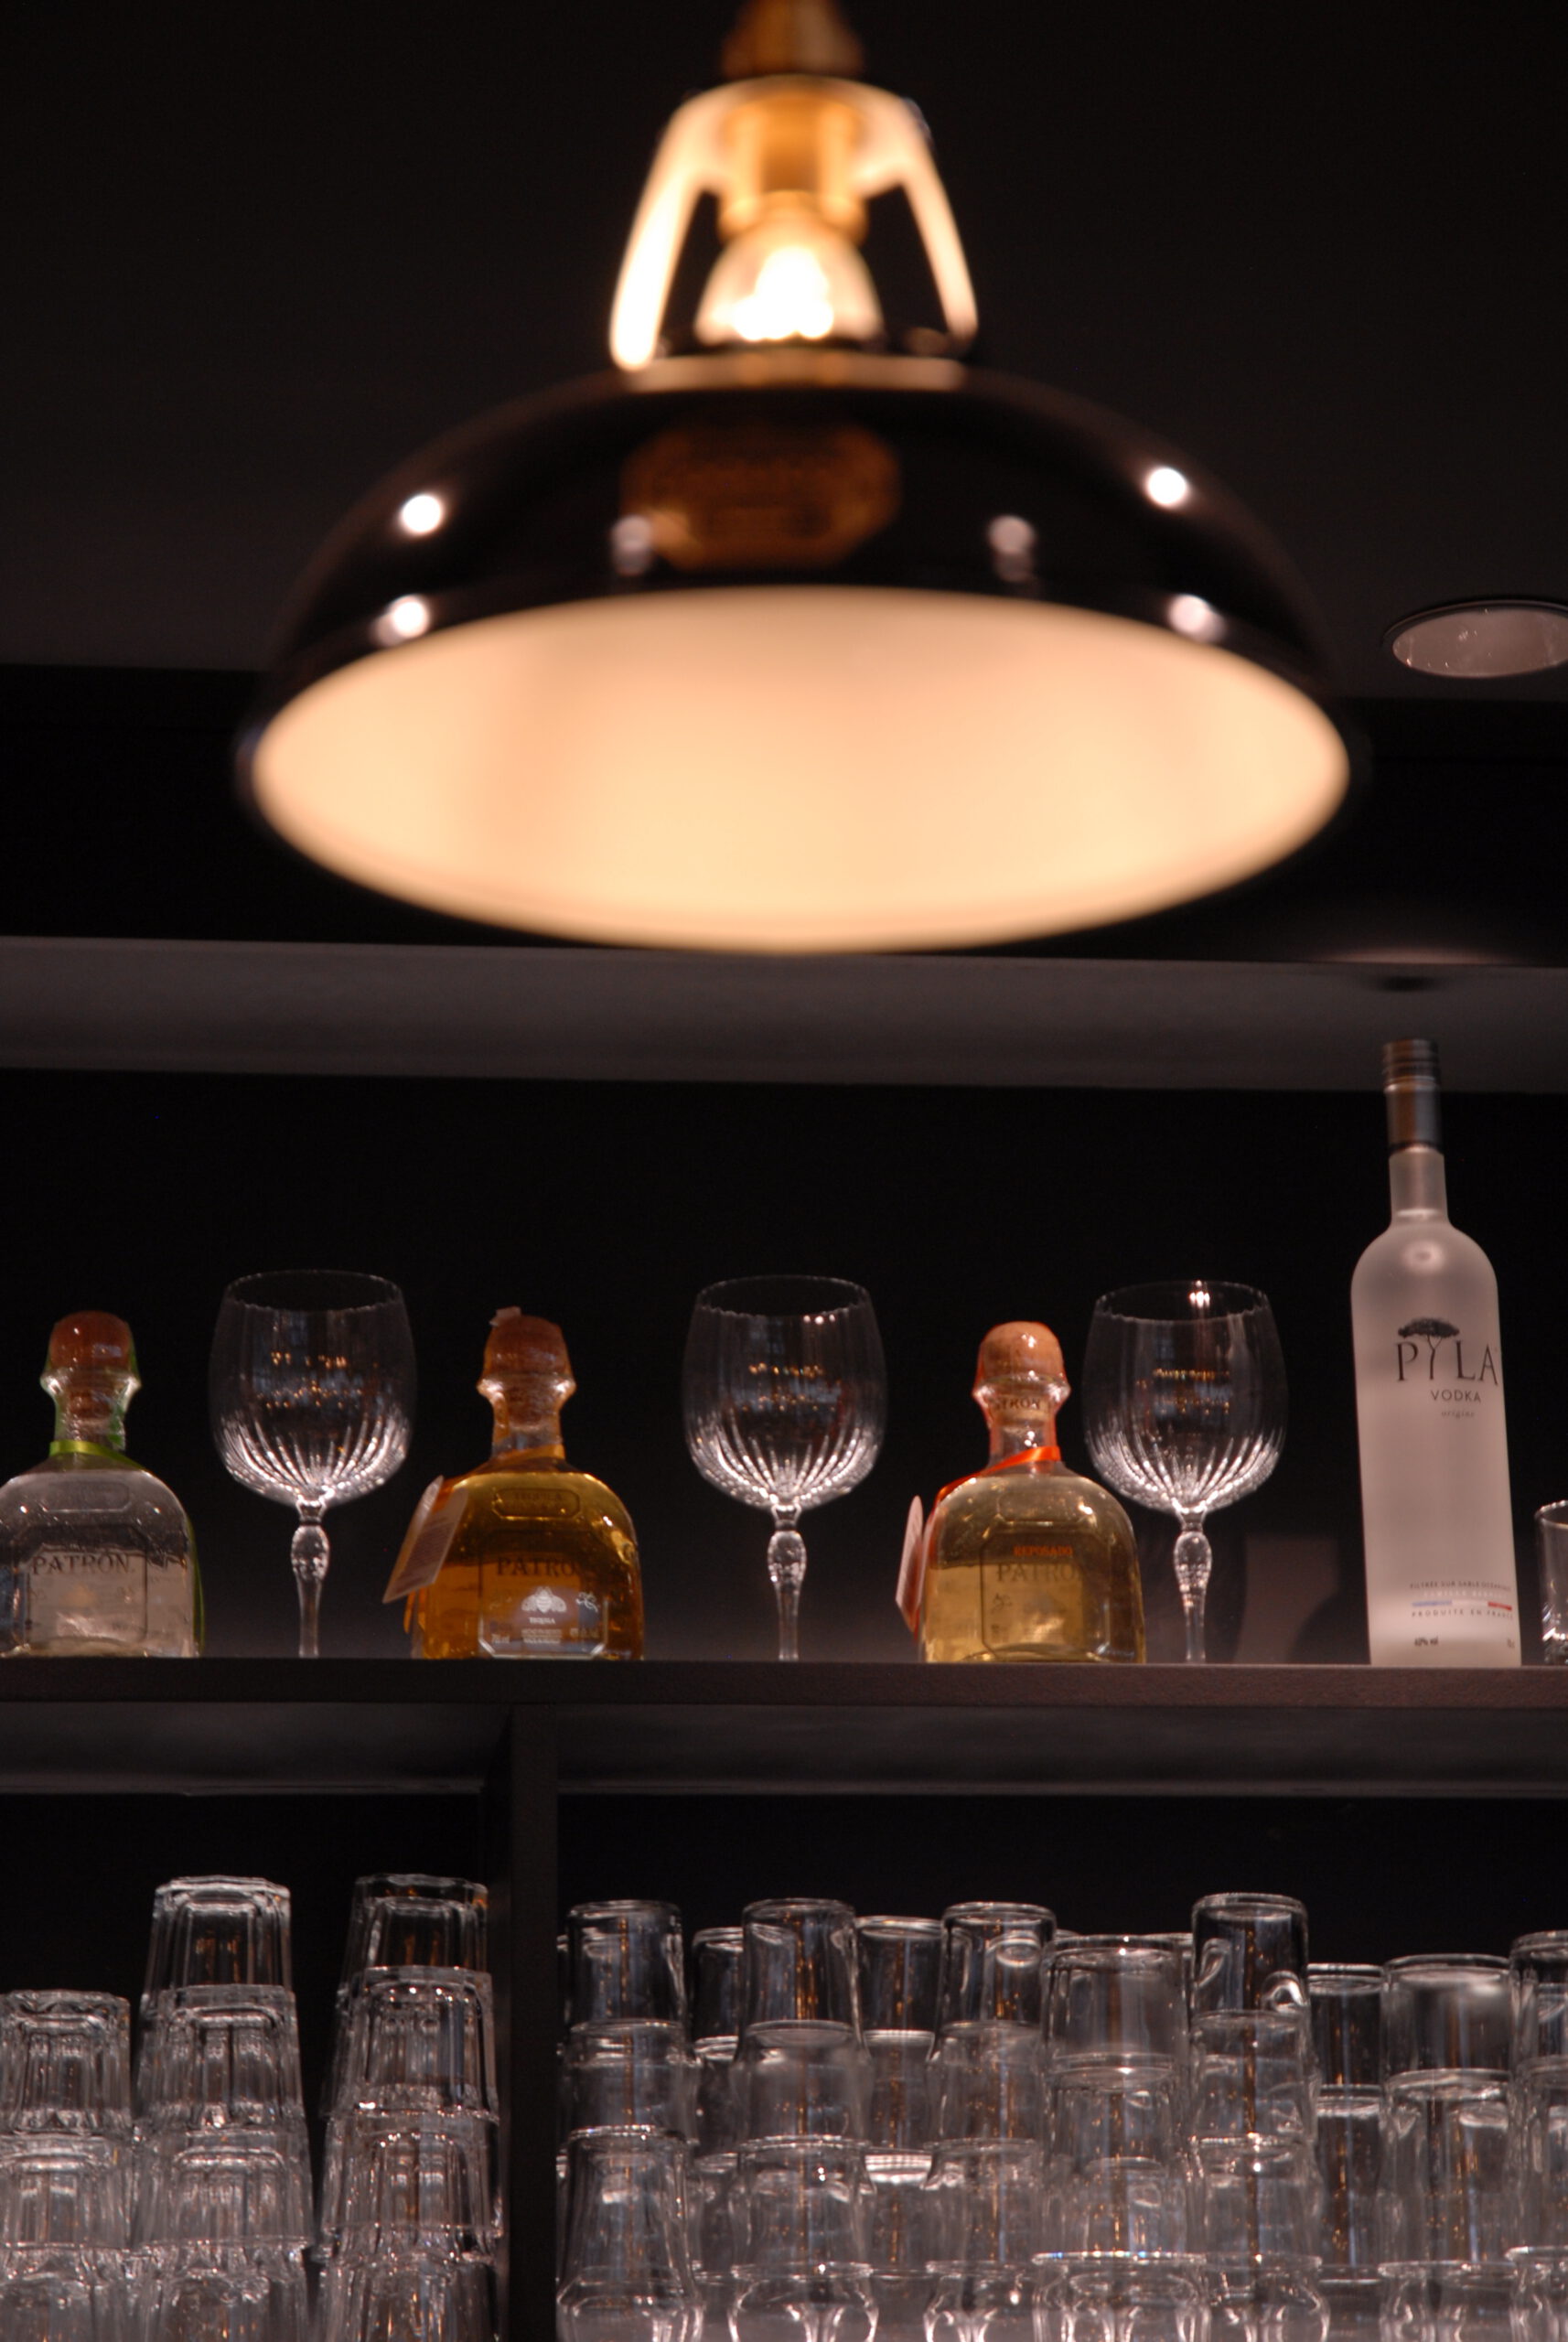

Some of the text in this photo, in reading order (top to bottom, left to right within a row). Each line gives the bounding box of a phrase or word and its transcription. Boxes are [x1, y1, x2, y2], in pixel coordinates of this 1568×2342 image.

[1395, 1335, 1498, 1387] PYLA
[1430, 1389, 1481, 1402] VODKA
[1013, 1545, 1072, 1556] REPOSADO
[1470, 1608, 1482, 1617] EN
